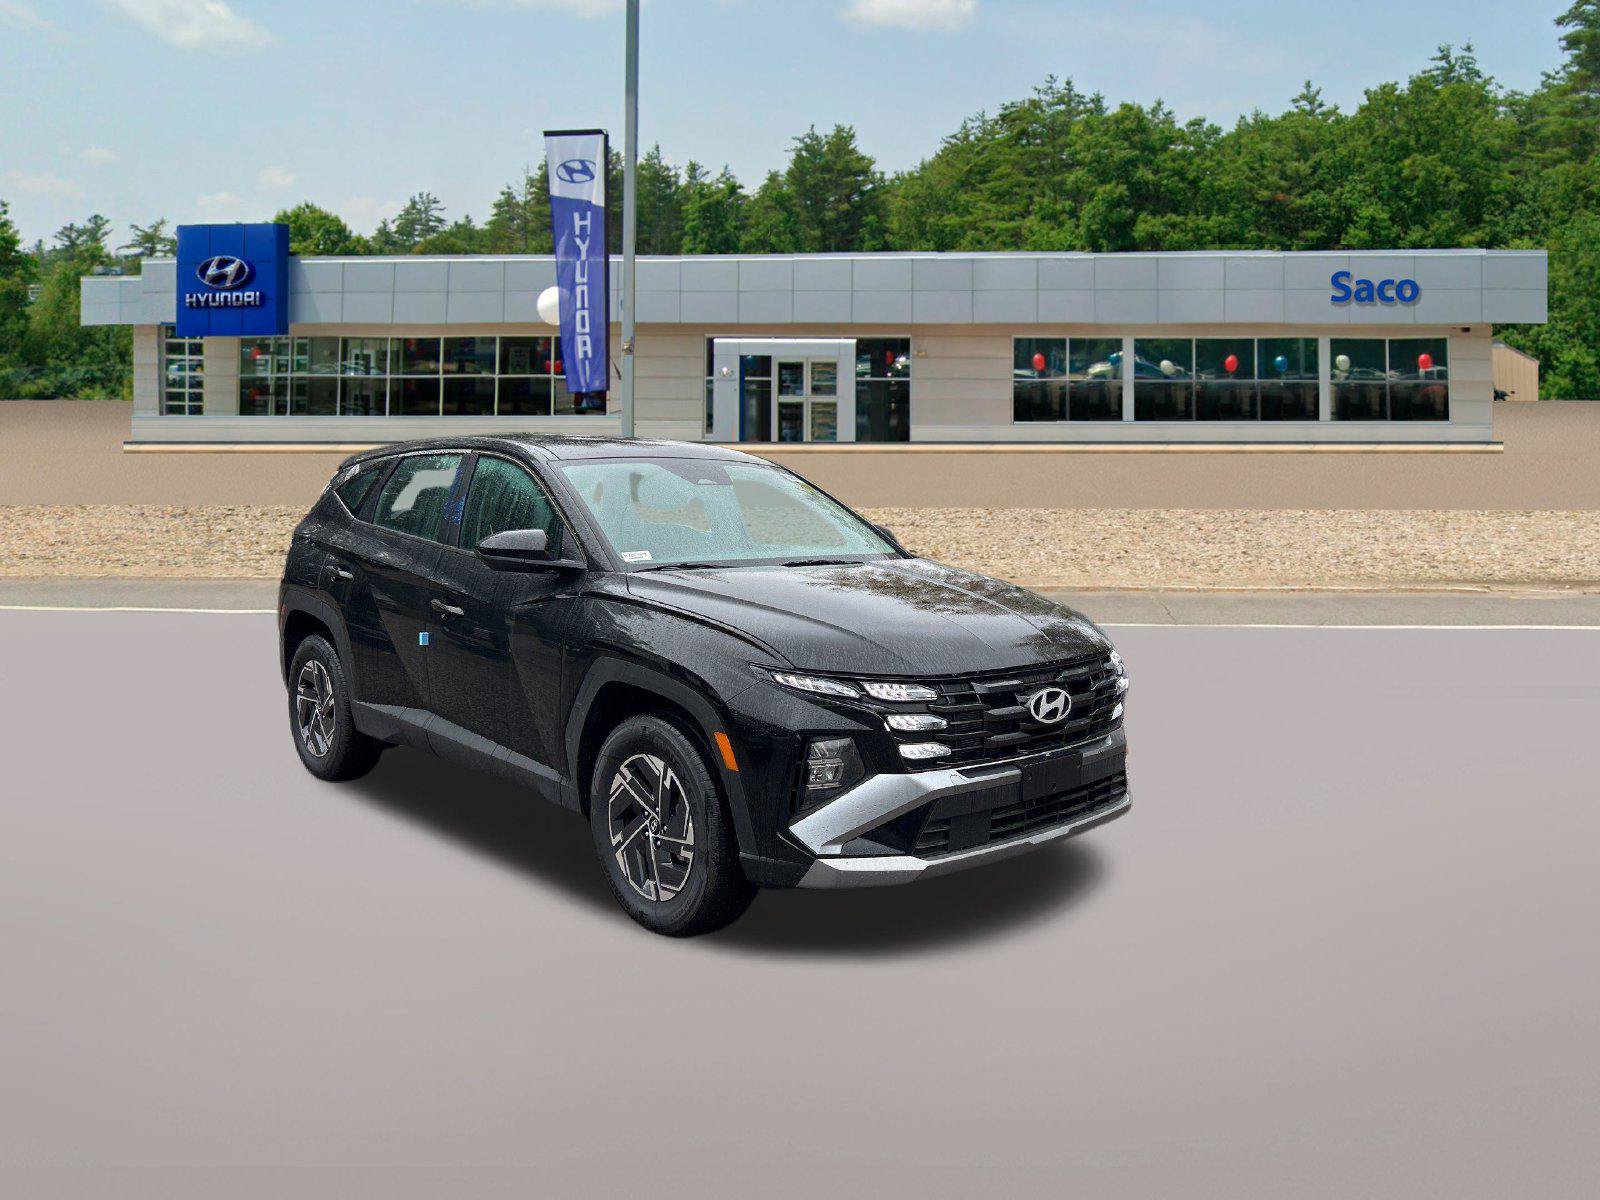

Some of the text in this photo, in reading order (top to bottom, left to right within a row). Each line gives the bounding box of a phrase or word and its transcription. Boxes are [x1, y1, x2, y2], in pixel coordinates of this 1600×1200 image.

[185, 291, 261, 307] HYUNDAI
[573, 211, 592, 384] HYUNDAI
[1330, 270, 1420, 303] Saco
